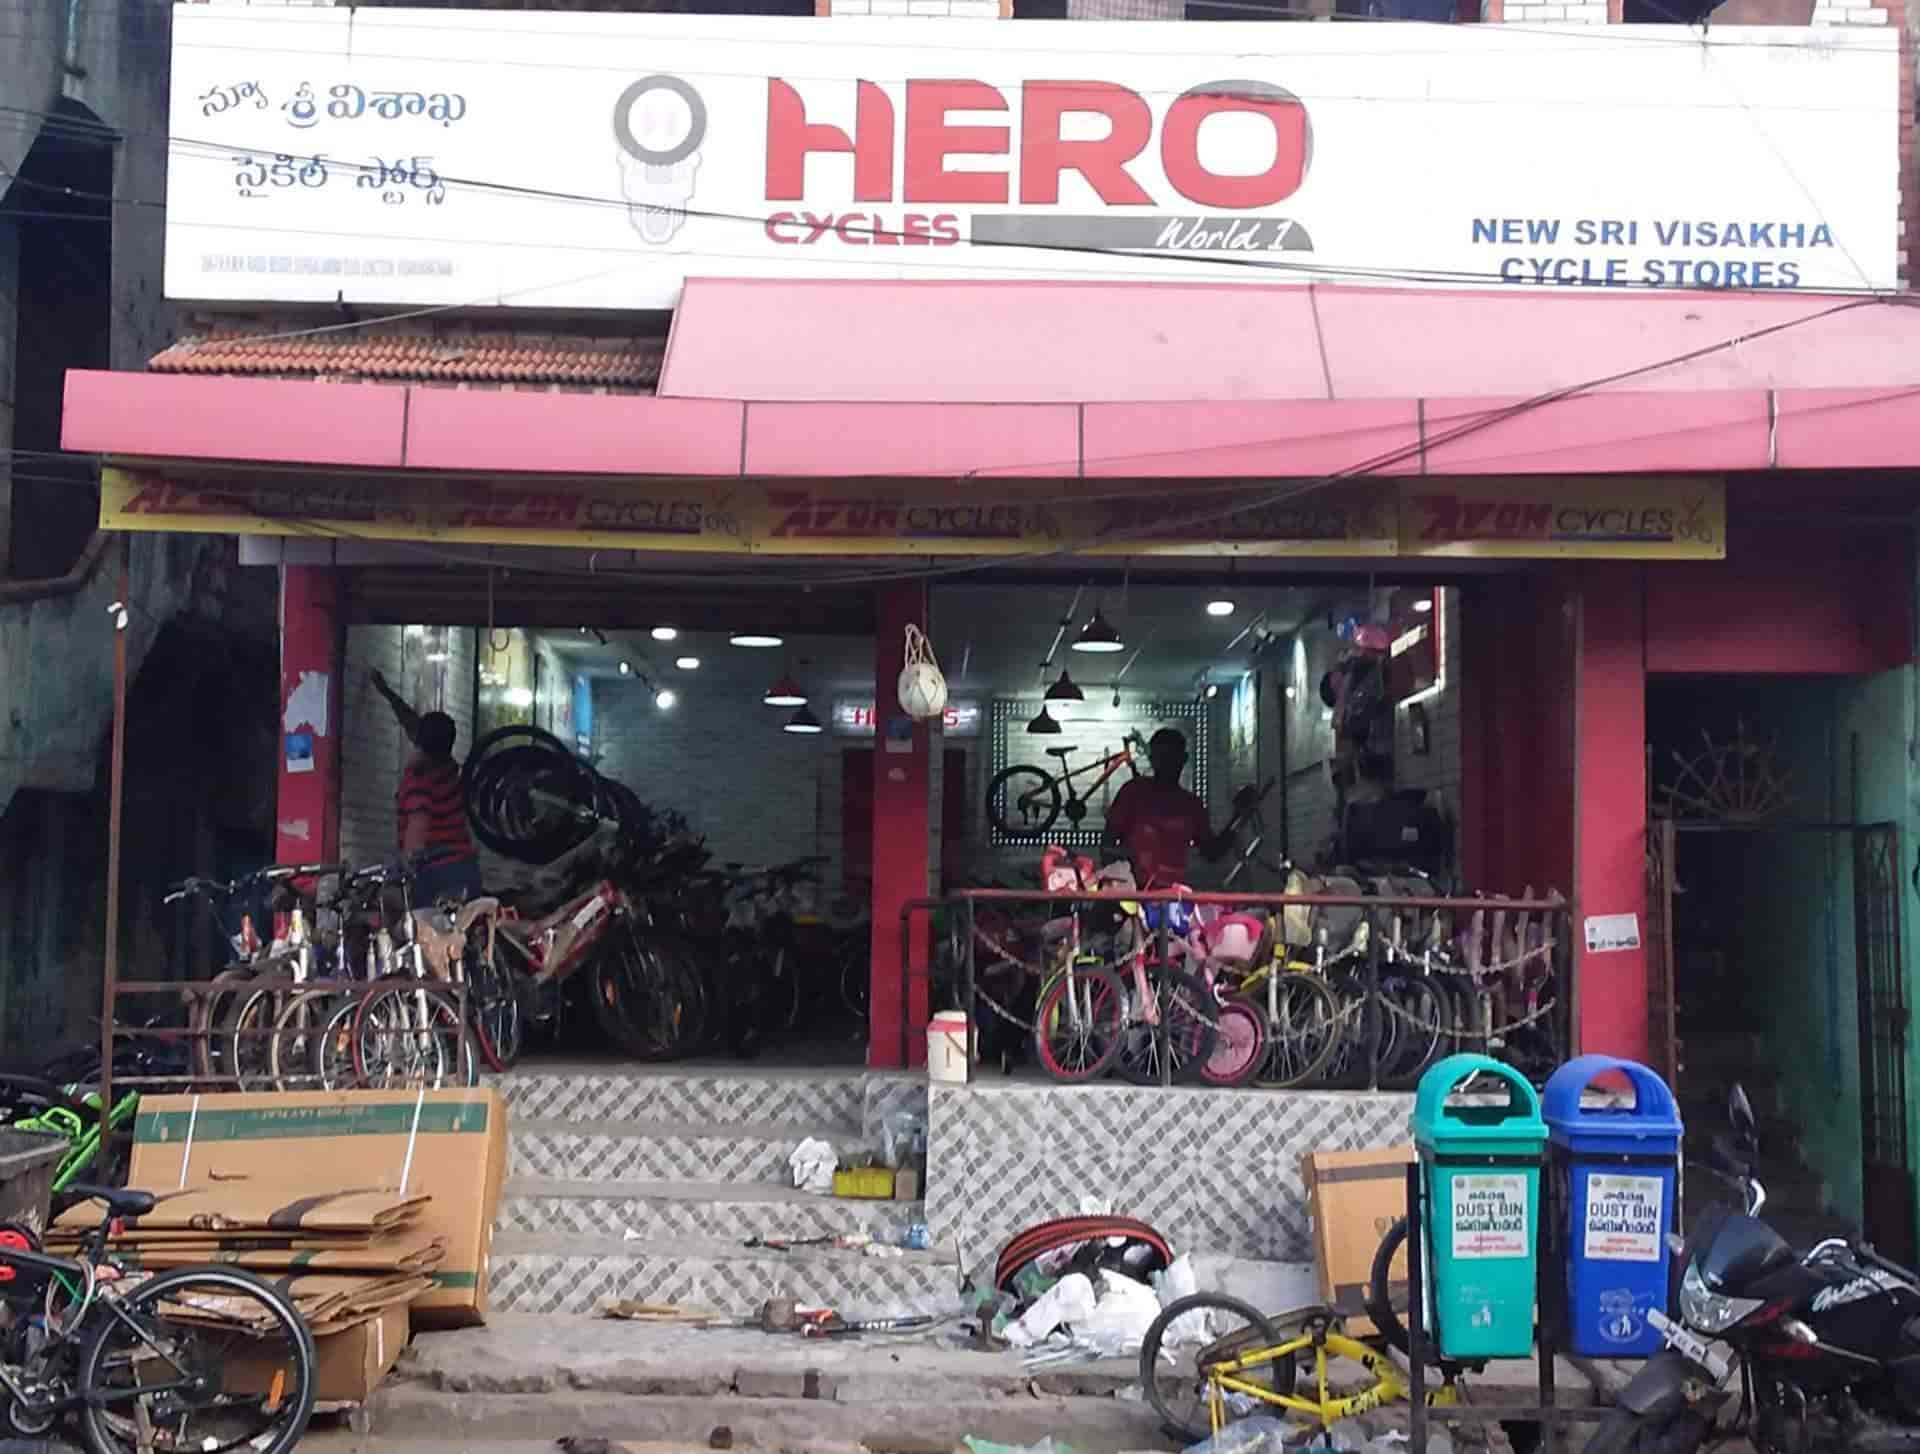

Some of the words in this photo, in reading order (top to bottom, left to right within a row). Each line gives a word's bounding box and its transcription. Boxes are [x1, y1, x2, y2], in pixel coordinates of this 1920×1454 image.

[281, 80, 320, 129] శ్రీ
[327, 83, 467, 128] విశాఖ
[764, 77, 1312, 209] HERO
[764, 211, 960, 246] CYCLES
[1155, 215, 1262, 250] World
[1268, 219, 1290, 251] 1
[1471, 218, 1561, 245] NEW
[1574, 219, 1638, 246] SRI
[1653, 220, 1834, 249] VISAKHA
[1499, 257, 1629, 287] CYCLE
[1641, 258, 1802, 289] STORES
[585, 497, 704, 525] CYCLES
[906, 500, 1023, 530] CYCLES
[1556, 505, 1673, 534] CYCLES
[1456, 1202, 1494, 1217] DUST
[1499, 1202, 1523, 1217] BIN
[1590, 1202, 1628, 1218] DUST
[1633, 1203, 1657, 1219] BIN
